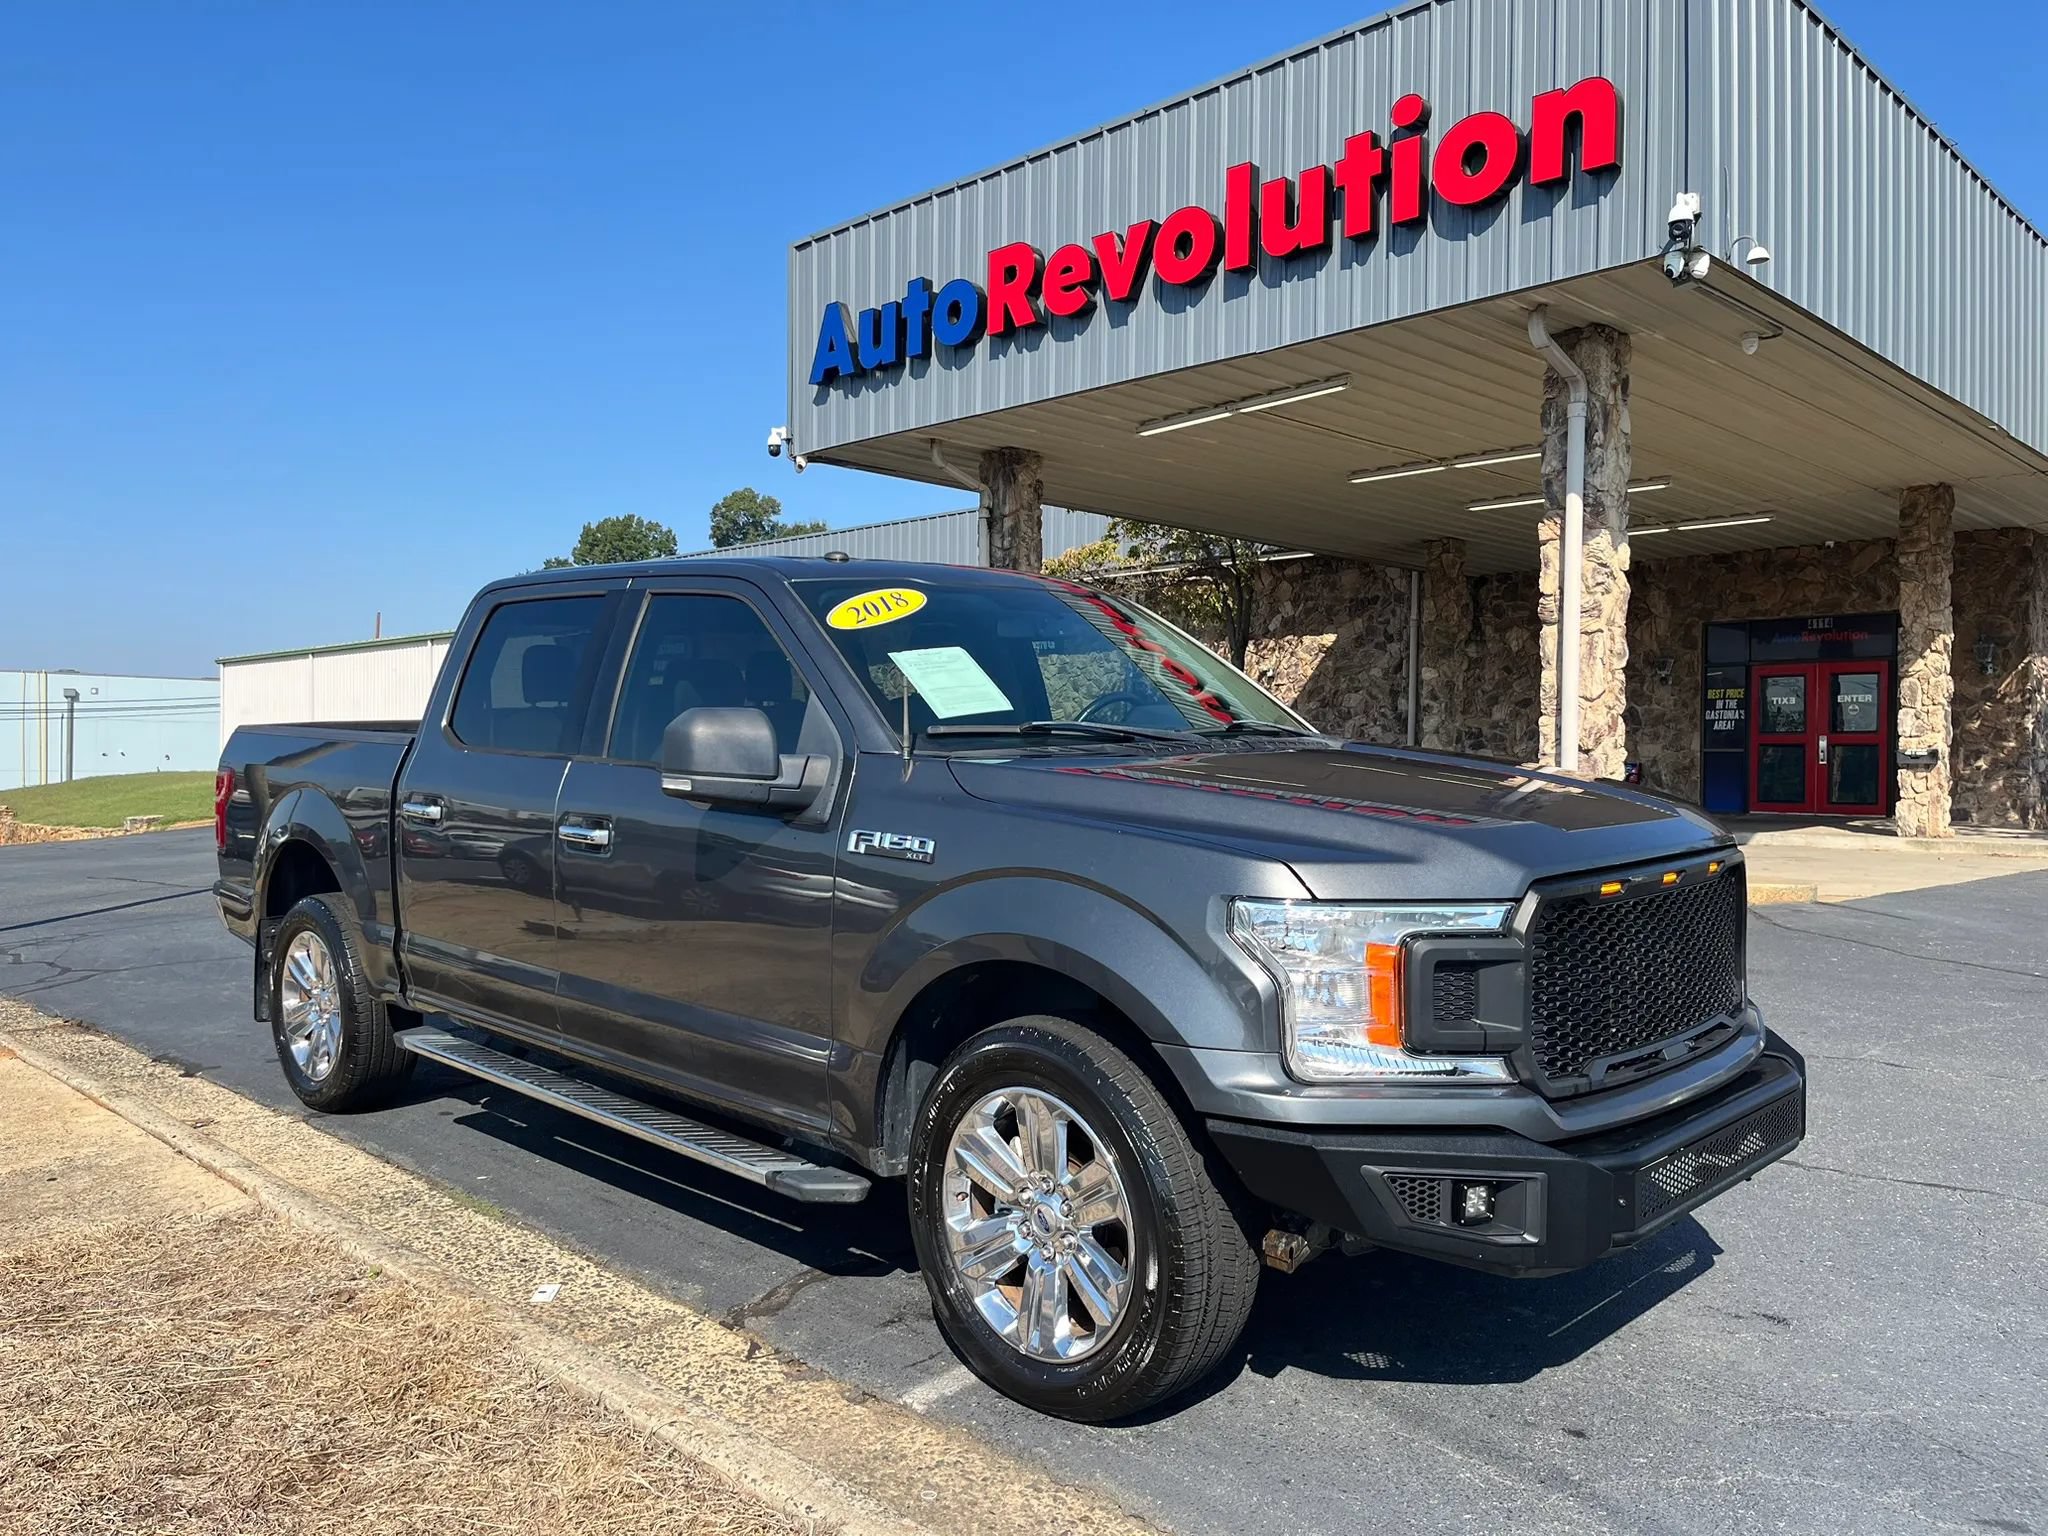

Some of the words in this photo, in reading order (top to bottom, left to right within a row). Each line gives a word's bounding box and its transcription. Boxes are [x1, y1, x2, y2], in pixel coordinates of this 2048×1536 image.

[809, 75, 1623, 386] AutoRevolution
[846, 591, 910, 624] 2018
[1707, 689, 1725, 699] BEST
[1725, 688, 1745, 698] PRICE
[1837, 694, 1873, 703] ENTER
[1715, 699, 1724, 709] IN
[1725, 699, 1738, 709] THE
[1713, 720, 1735, 730] AREA!
[906, 852, 924, 860] XLT
